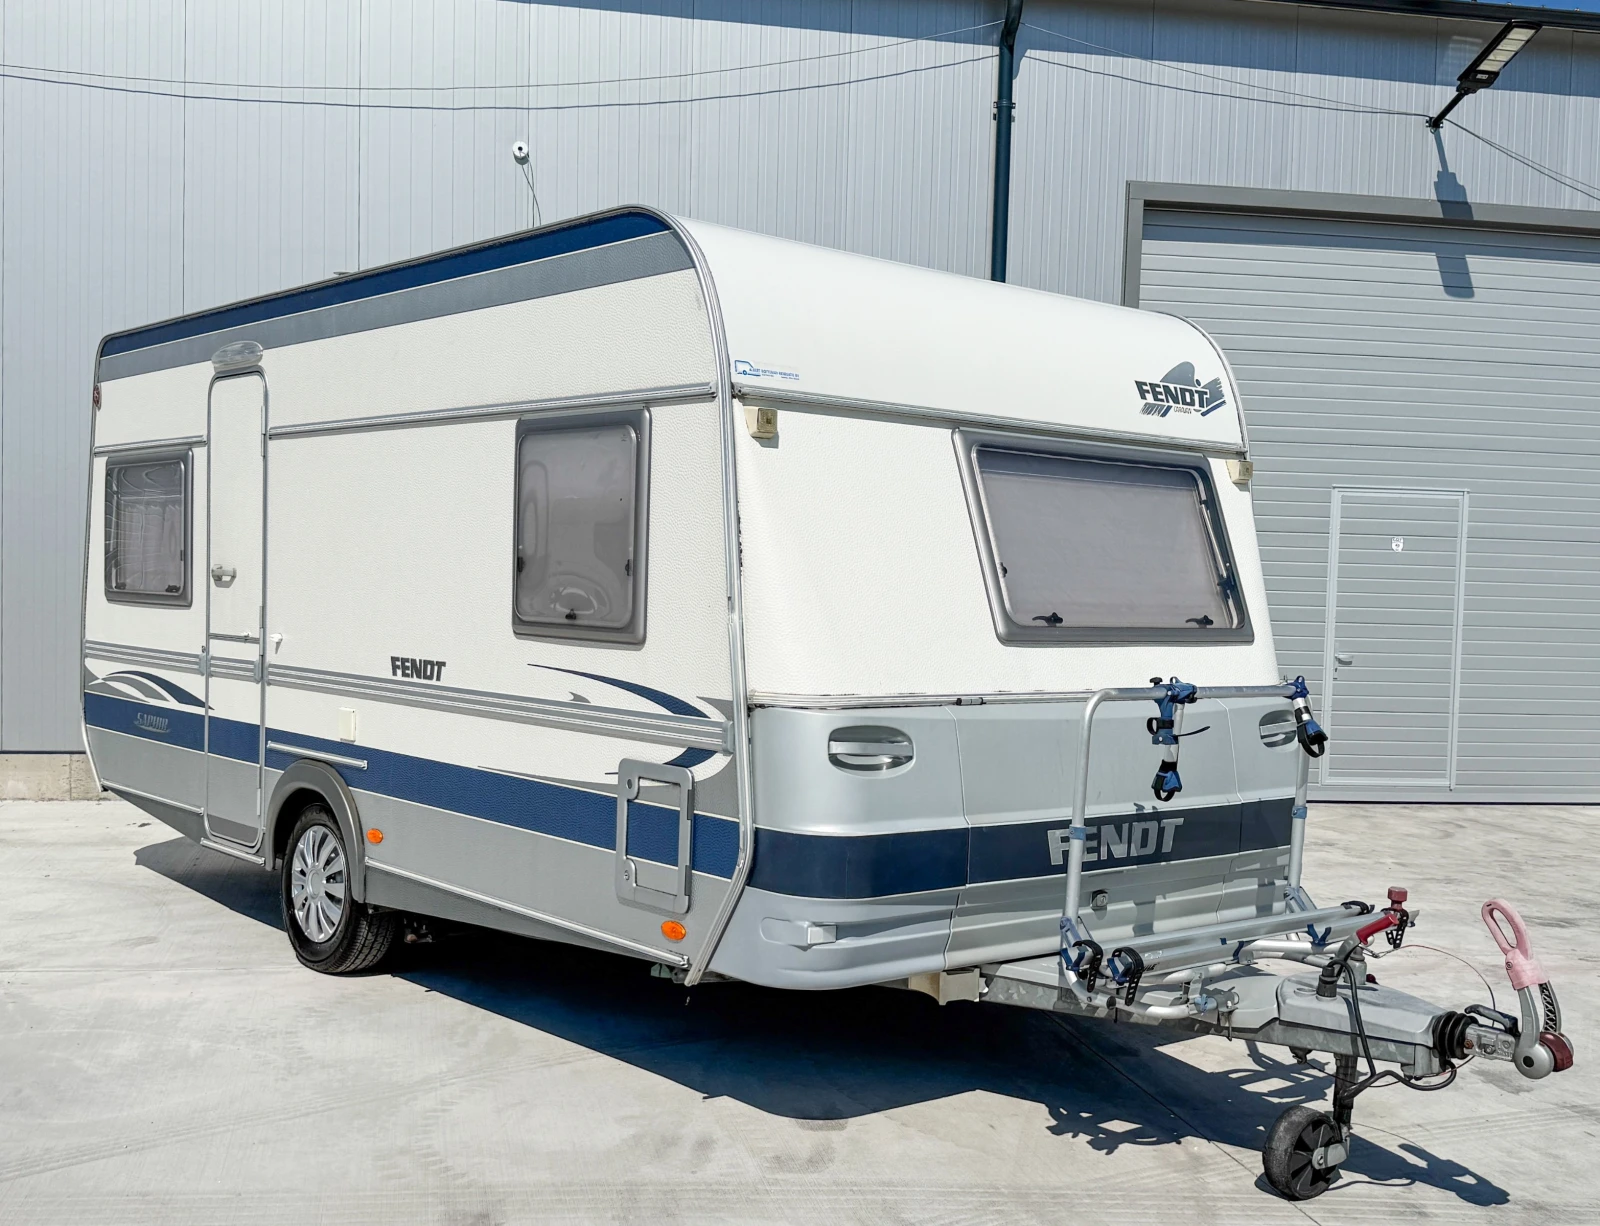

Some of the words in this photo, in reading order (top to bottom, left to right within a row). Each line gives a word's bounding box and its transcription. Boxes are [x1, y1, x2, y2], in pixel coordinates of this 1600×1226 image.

[1134, 380, 1209, 409] FENDT
[390, 656, 446, 681] FENDT
[137, 712, 168, 731] SAPHIR
[1047, 818, 1184, 865] FENDT
